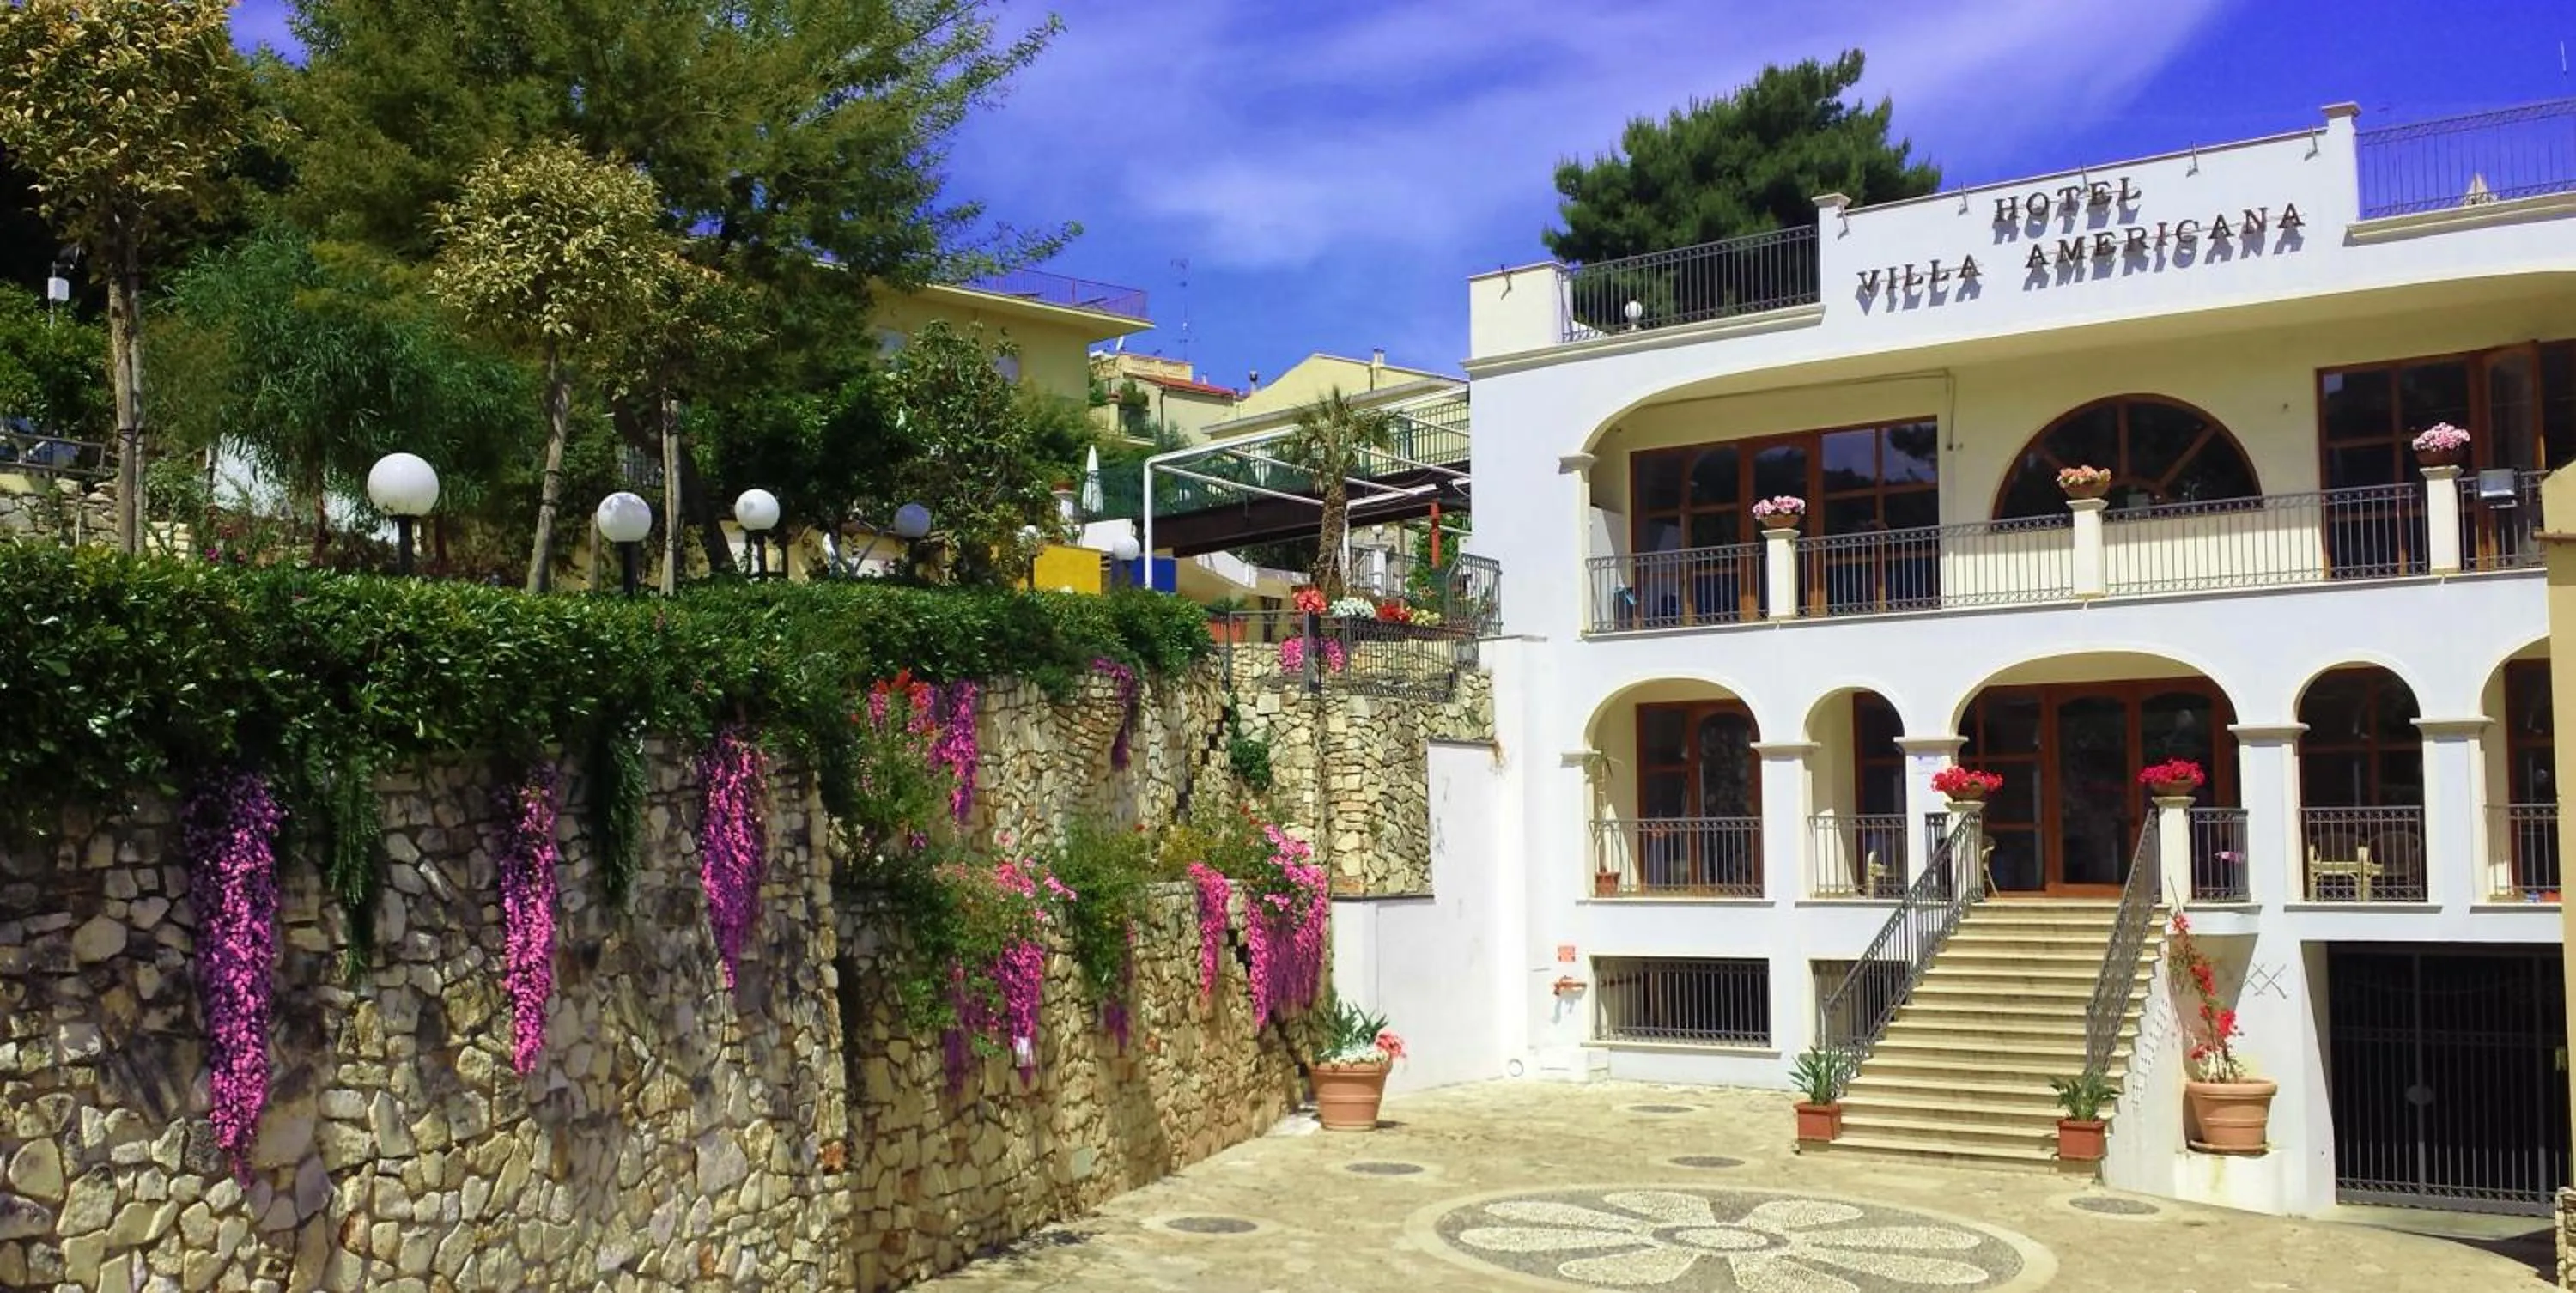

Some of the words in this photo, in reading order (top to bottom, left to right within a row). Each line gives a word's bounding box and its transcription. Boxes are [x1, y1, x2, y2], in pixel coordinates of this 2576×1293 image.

[1994, 177, 2142, 223] HOTEL
[1857, 254, 1982, 293] VILLA
[2026, 203, 2305, 269] AMERICANA
